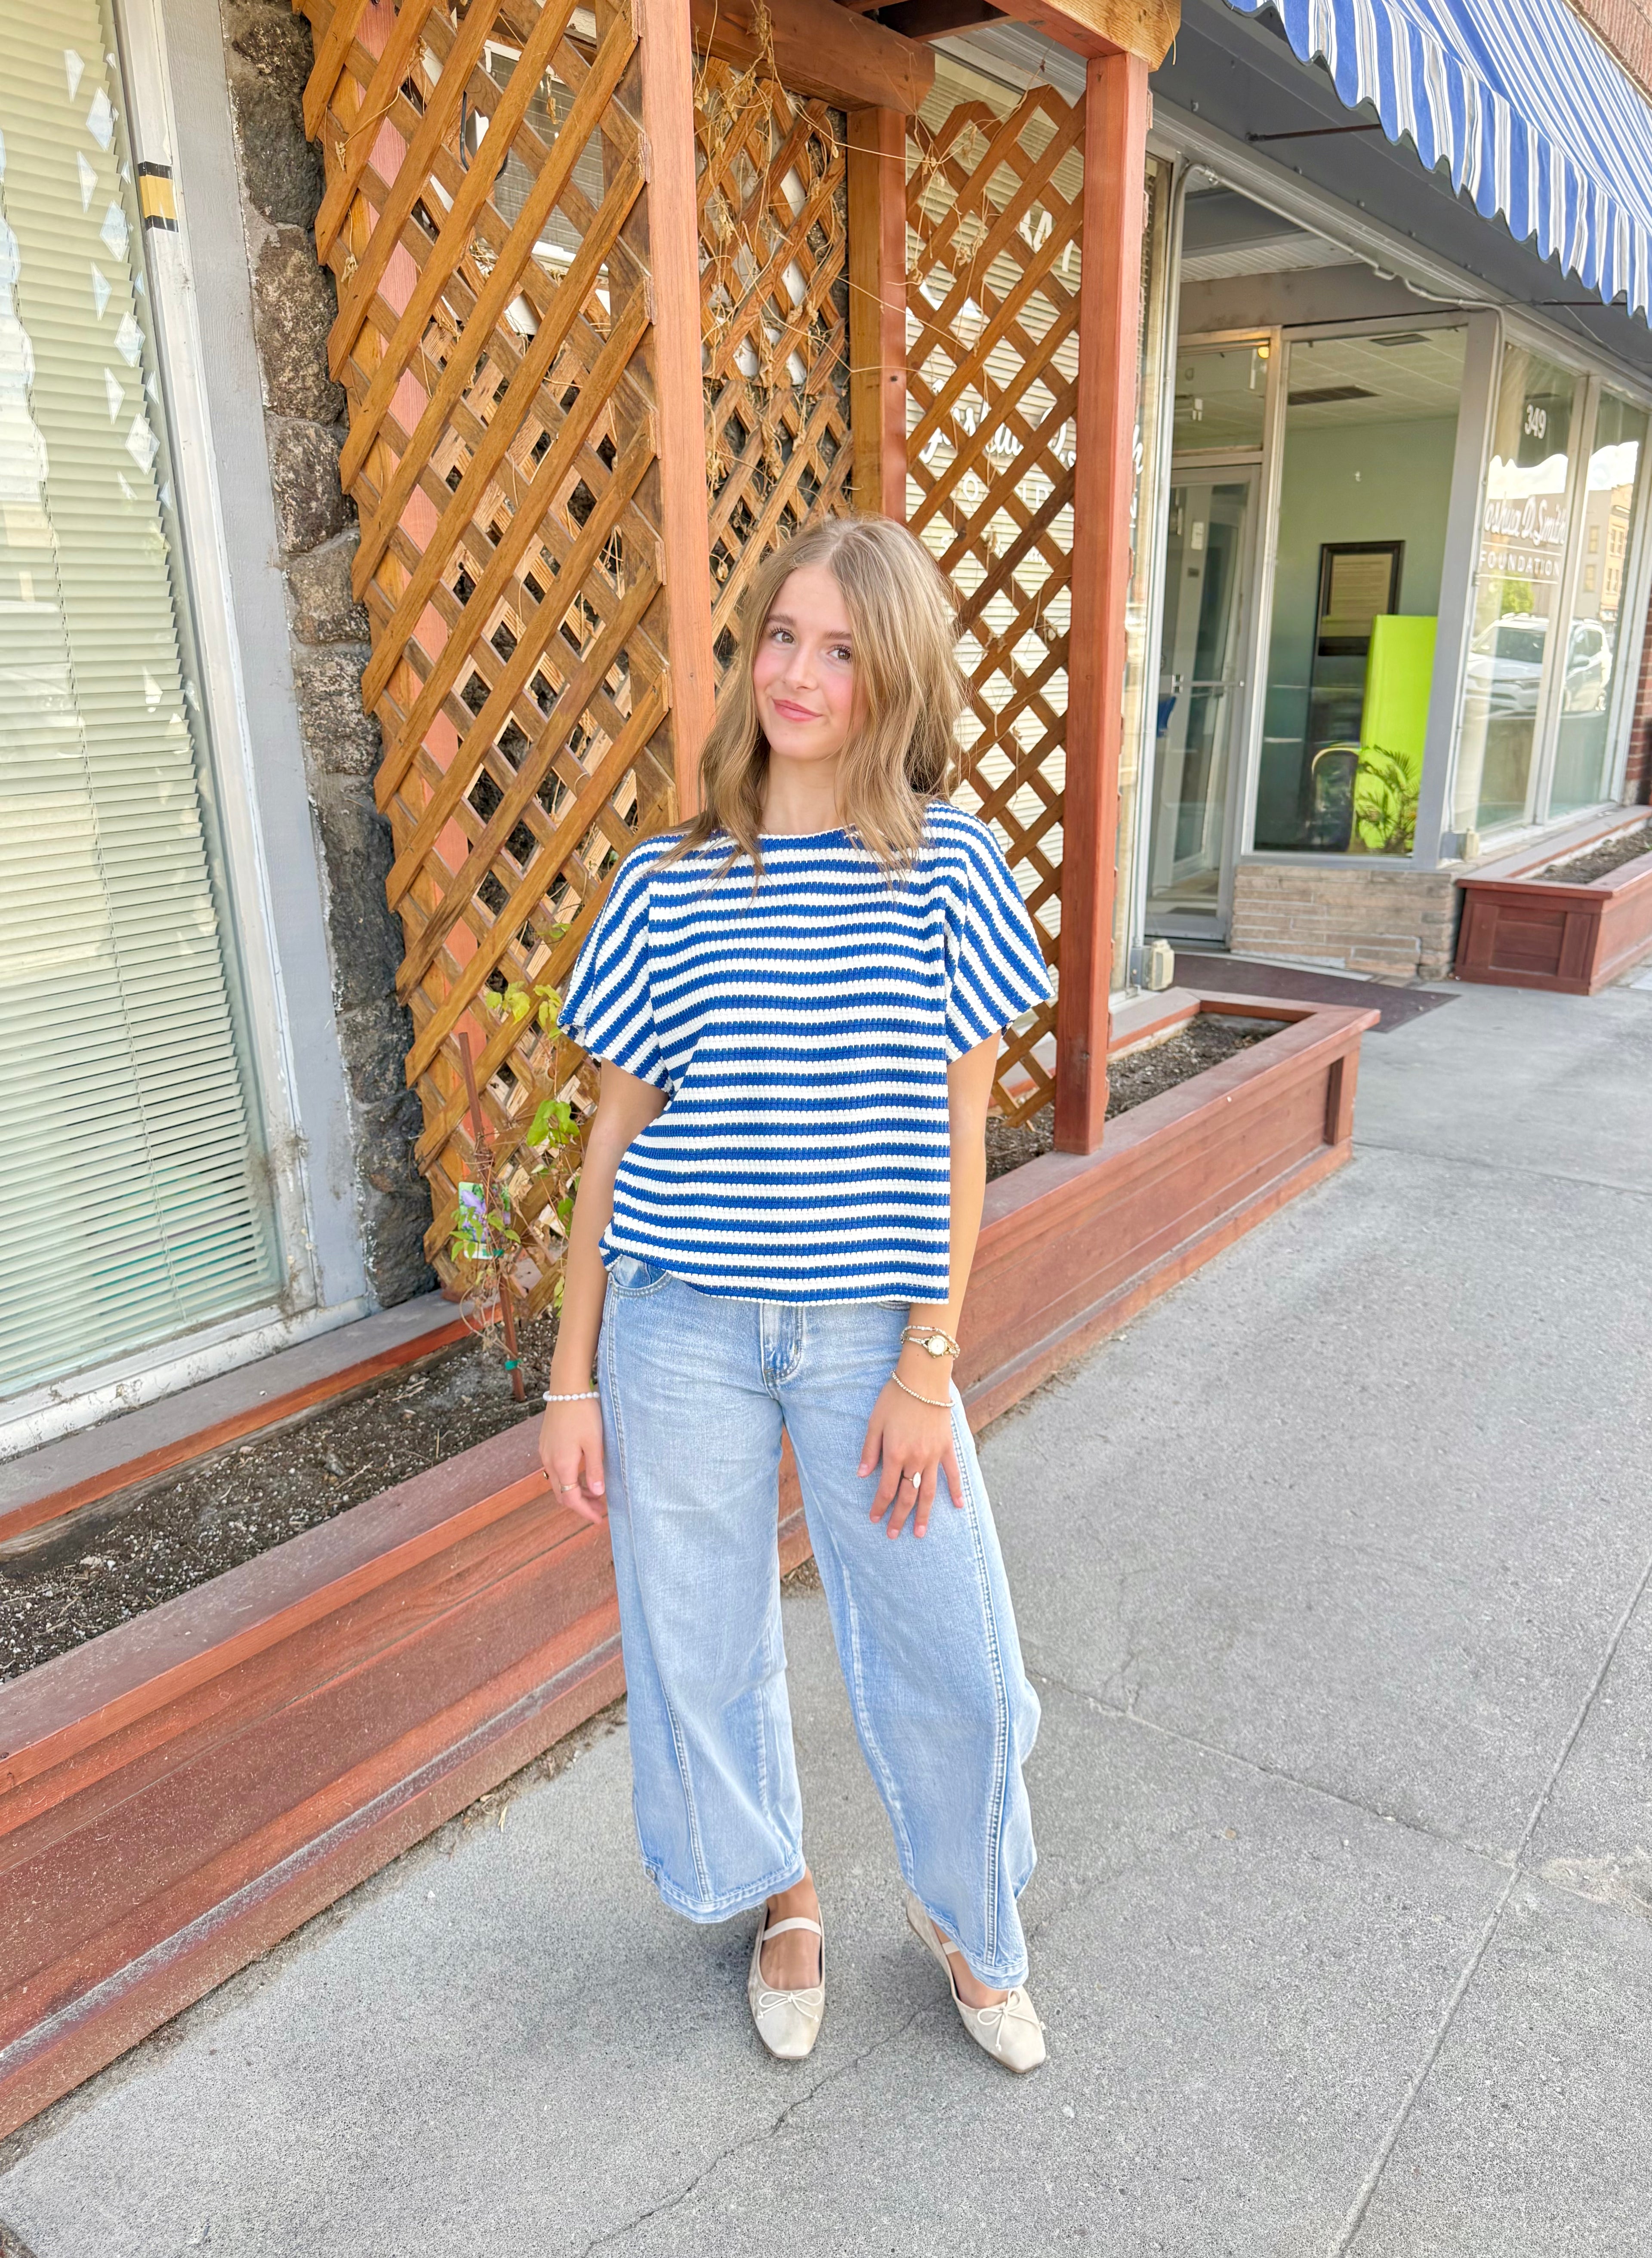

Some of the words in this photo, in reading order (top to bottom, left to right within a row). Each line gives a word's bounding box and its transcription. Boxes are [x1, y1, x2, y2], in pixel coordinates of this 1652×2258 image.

[1525, 404, 1547, 439] 349
[1485, 493, 1521, 537] oshua
[1478, 550, 1560, 576] FOUNDATION
